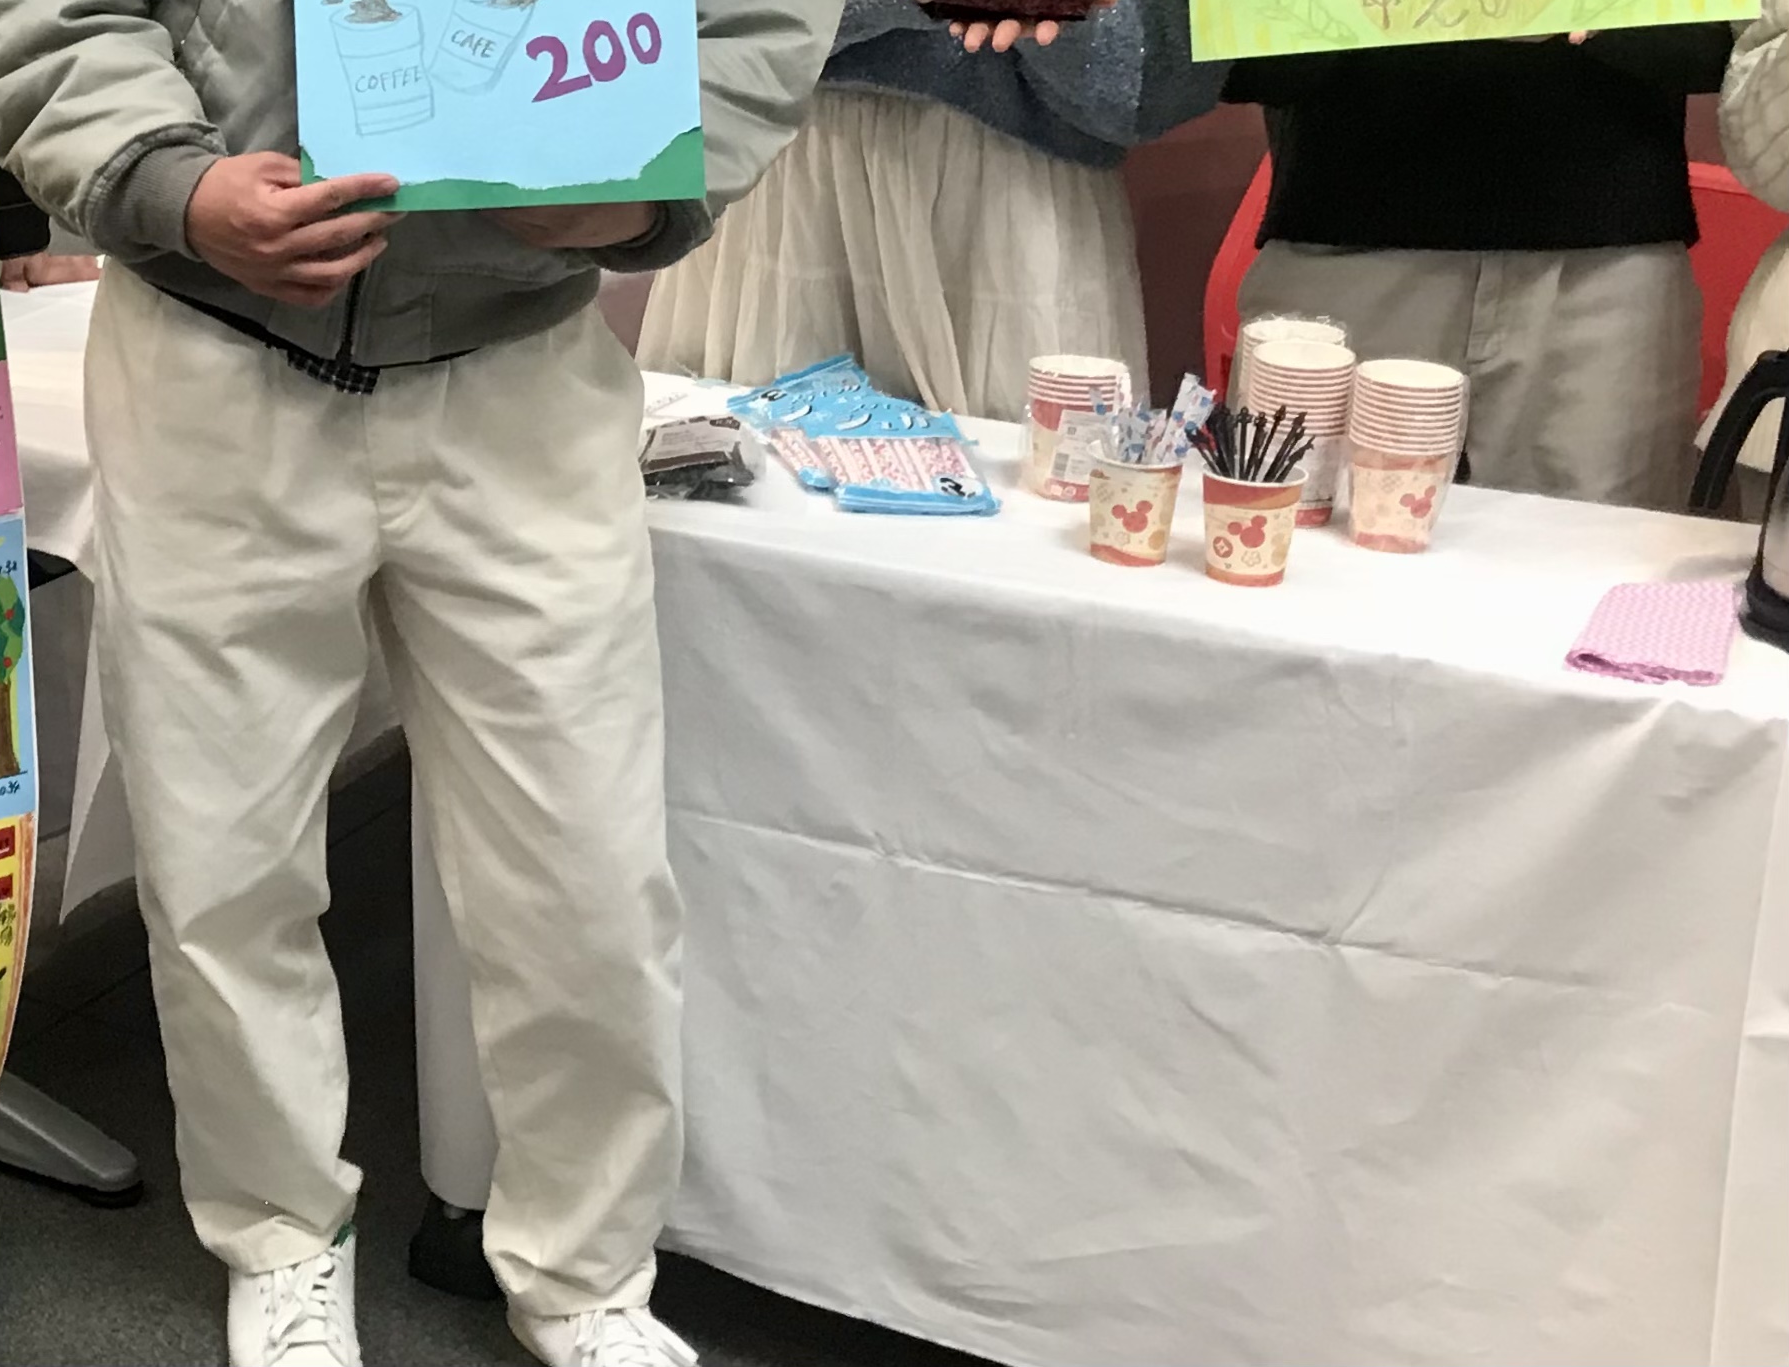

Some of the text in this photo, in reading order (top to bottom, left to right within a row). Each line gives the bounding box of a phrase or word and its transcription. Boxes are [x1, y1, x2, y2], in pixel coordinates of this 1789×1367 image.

[451, 28, 498, 60] CAFE
[525, 12, 662, 104] 200
[354, 64, 423, 93] COFFEE
